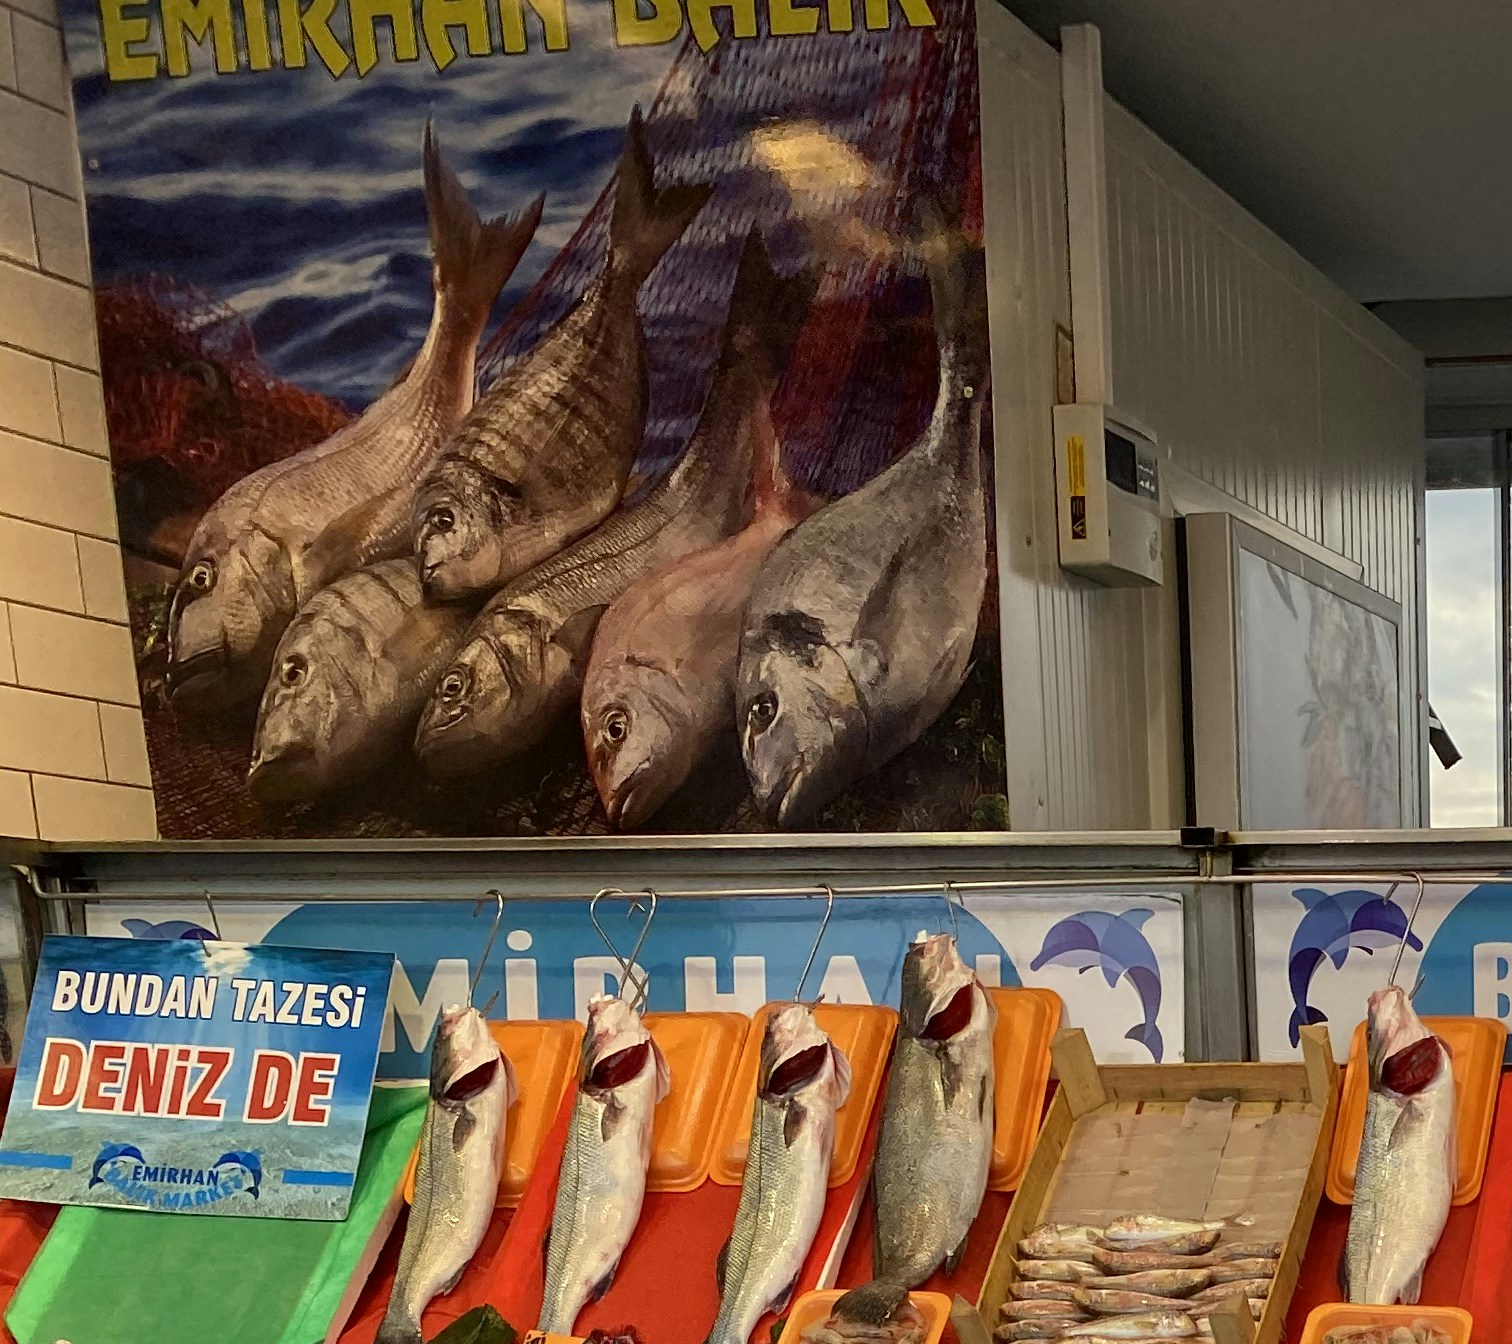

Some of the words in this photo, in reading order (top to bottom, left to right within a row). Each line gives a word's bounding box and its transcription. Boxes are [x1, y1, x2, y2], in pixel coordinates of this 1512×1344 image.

[52, 970, 219, 1019] BUNDAN
[32, 1038, 235, 1121] DENİZ
[242, 1049, 341, 1127] DE
[132, 1163, 220, 1187] EMİRHAN
